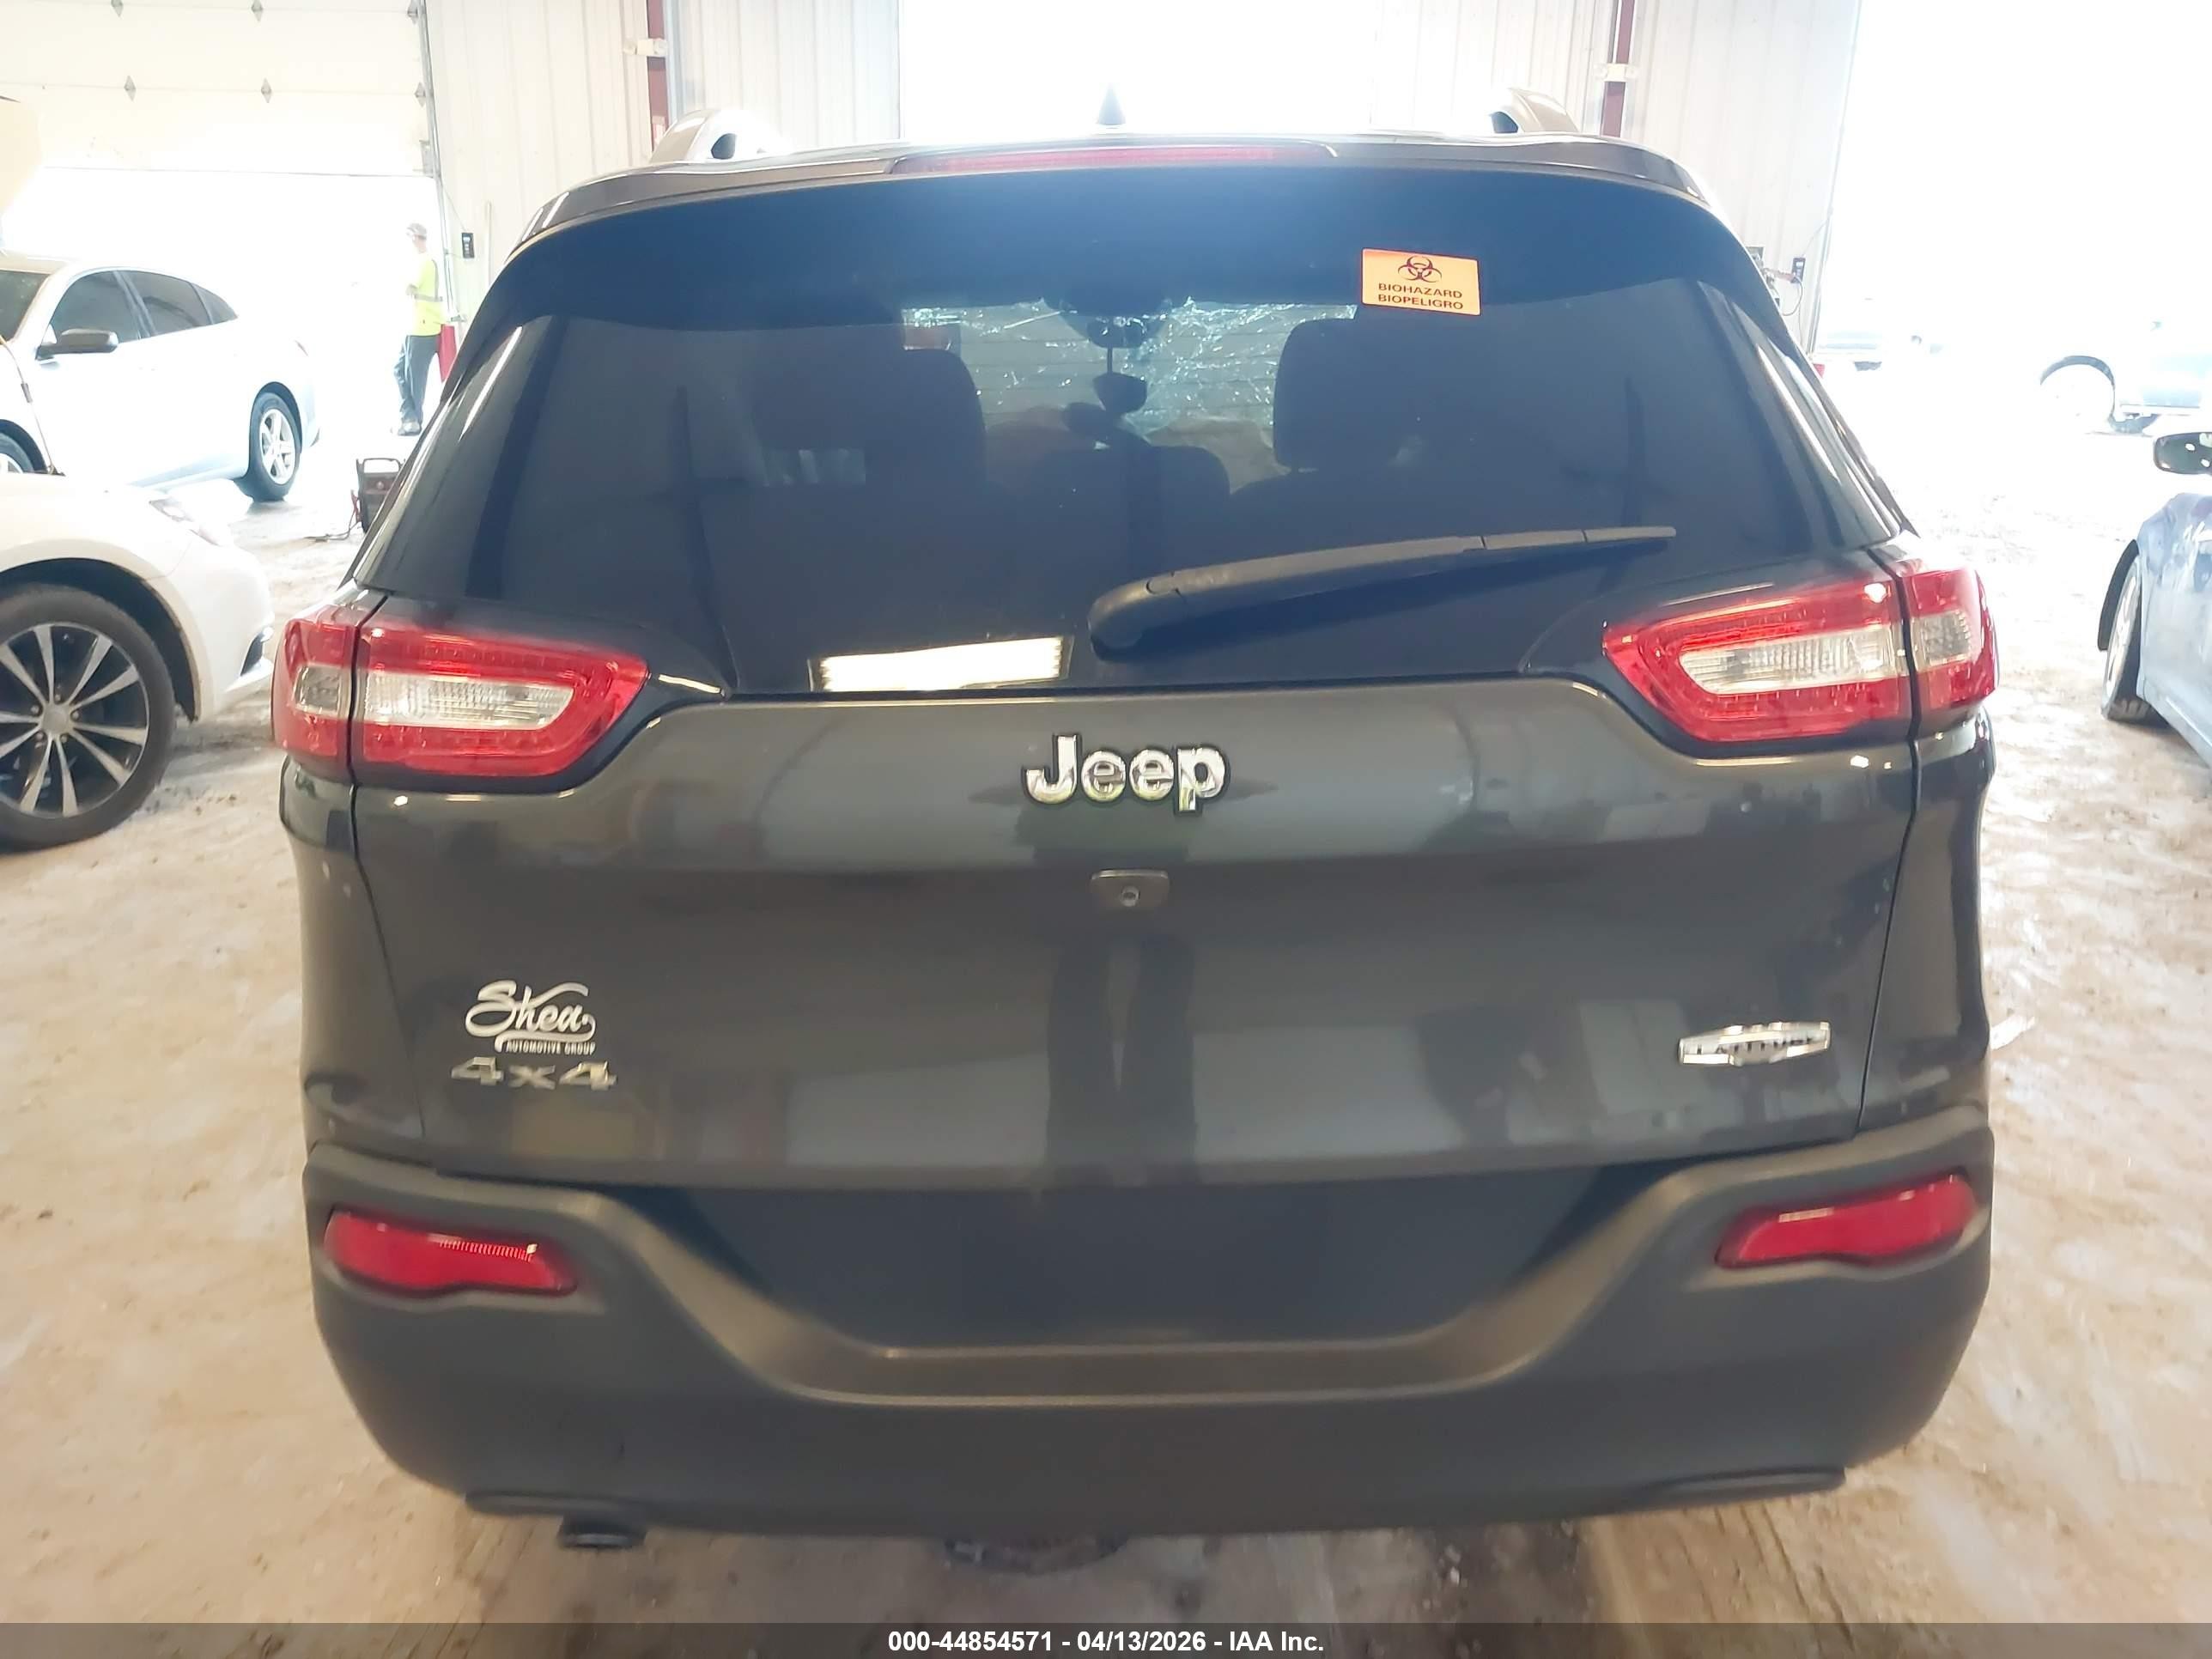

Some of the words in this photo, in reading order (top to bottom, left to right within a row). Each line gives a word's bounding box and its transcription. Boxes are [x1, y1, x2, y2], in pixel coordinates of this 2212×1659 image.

[1378, 283, 1462, 299] BIOHAZARD
[1378, 294, 1463, 310] BIOPELIGRO
[1024, 733, 1227, 813] Jeep
[465, 980, 596, 1053] Shea
[506, 1040, 562, 1054] AUTOMOTIVE
[564, 1041, 596, 1055] GROUP
